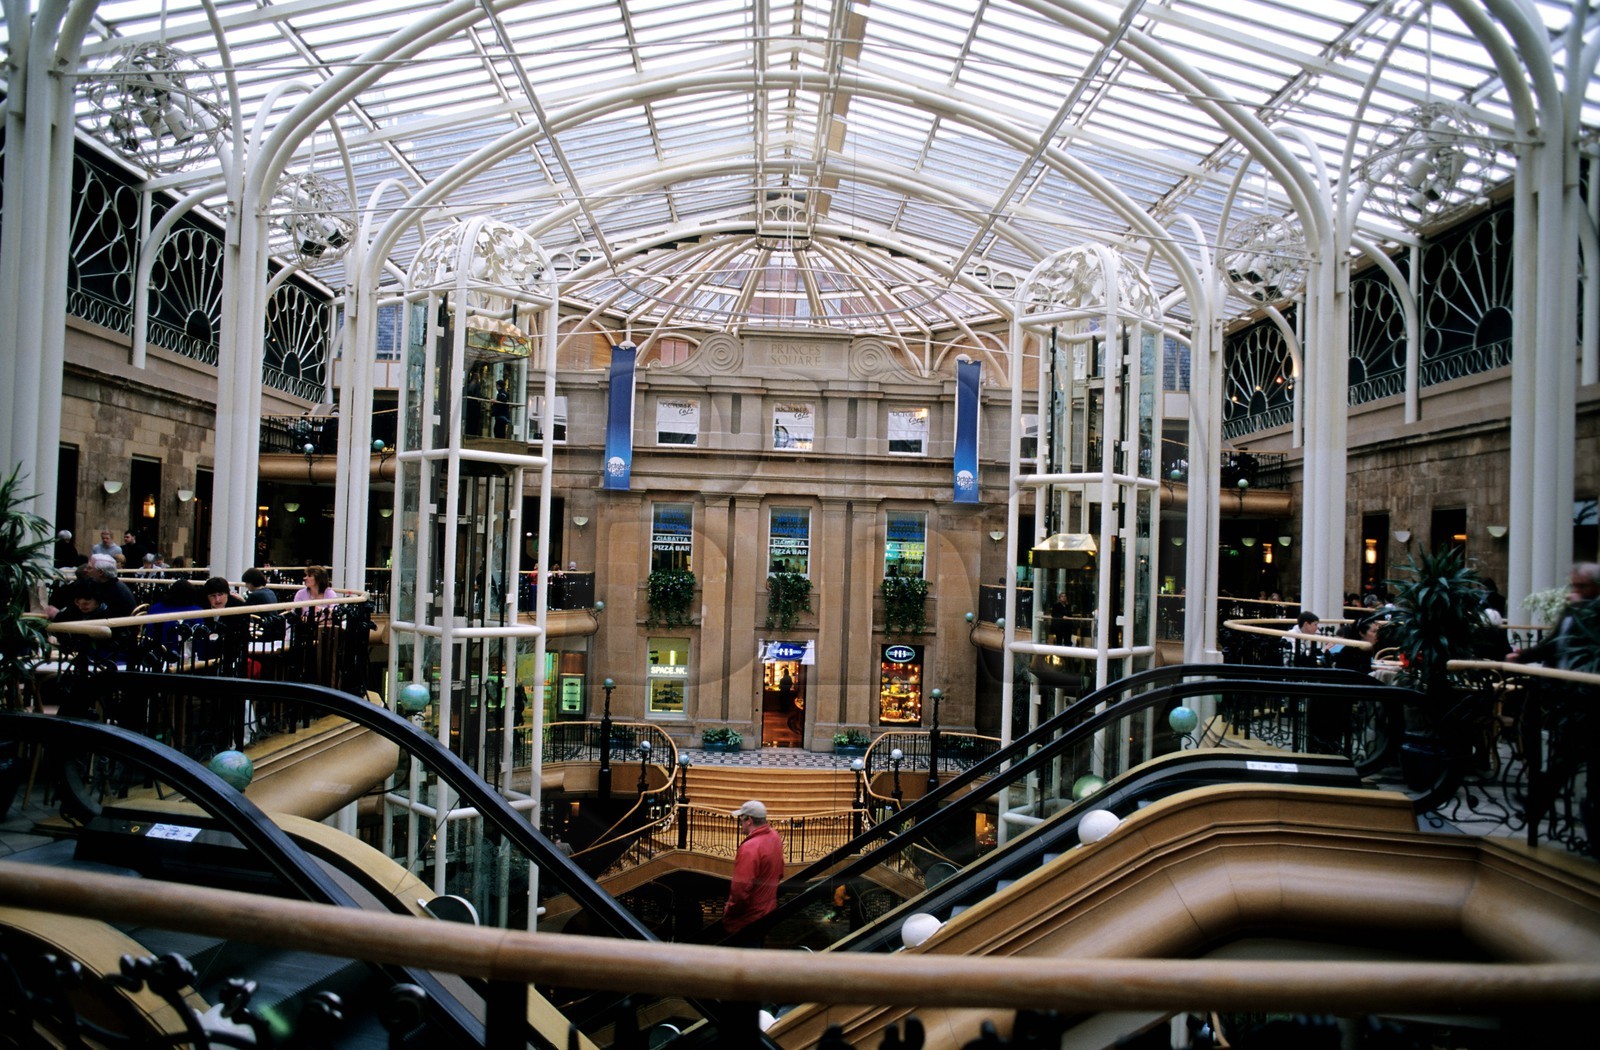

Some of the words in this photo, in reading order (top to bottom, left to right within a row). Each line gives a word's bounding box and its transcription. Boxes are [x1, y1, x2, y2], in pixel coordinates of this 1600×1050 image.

[771, 343, 821, 355] PRINCES
[770, 355, 821, 367] SQUARE
[771, 527, 808, 535] PAVONE
